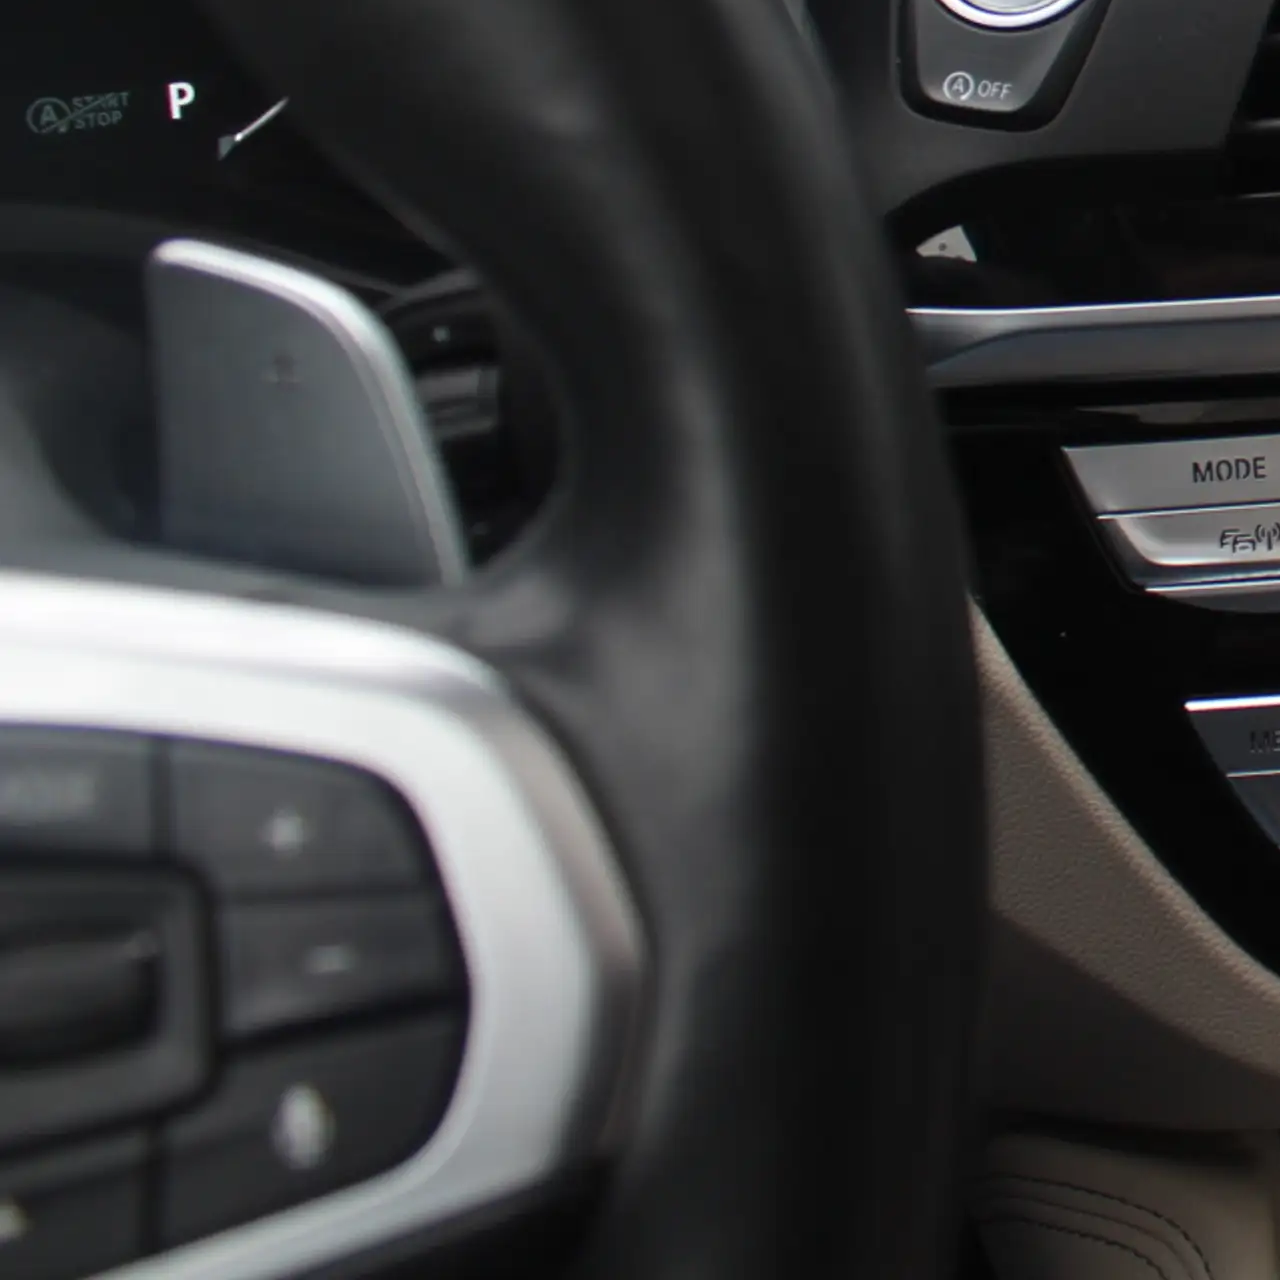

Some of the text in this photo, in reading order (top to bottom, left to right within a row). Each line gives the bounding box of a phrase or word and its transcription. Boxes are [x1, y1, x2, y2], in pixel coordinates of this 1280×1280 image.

[167, 81, 196, 120] P
[977, 79, 1013, 100] OFF
[1191, 456, 1268, 483] MODE
